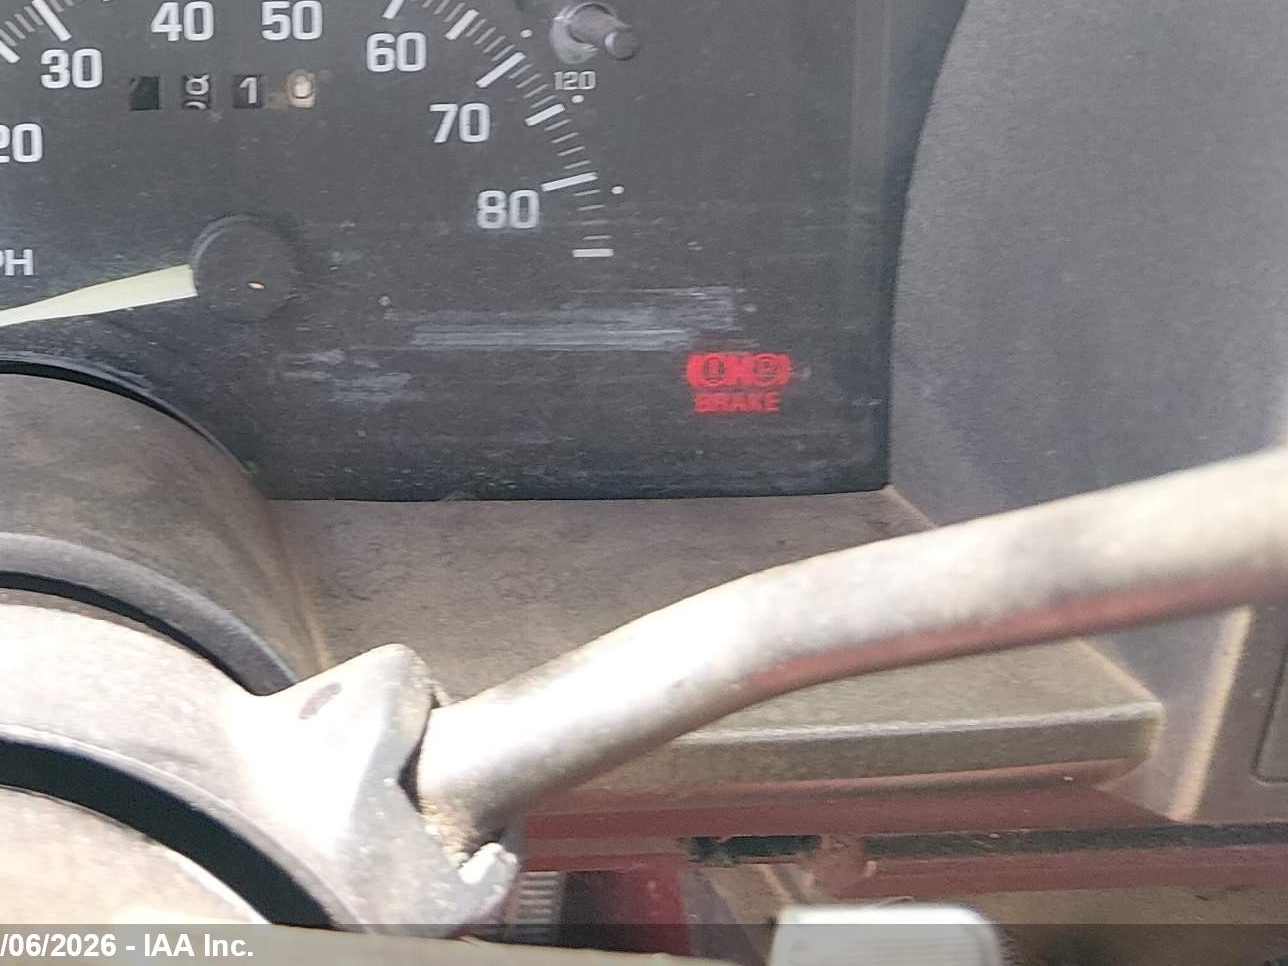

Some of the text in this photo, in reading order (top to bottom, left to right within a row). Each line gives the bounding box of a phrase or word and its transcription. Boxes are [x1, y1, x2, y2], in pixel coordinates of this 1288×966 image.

[150, 1, 214, 42] 40
[261, 0, 323, 41] 50
[40, 49, 103, 89] 30
[366, 33, 427, 72] 60
[553, 71, 596, 90] 120
[429, 103, 490, 143] 70
[476, 190, 540, 229] 80
[694, 392, 780, 413] BRAKE
